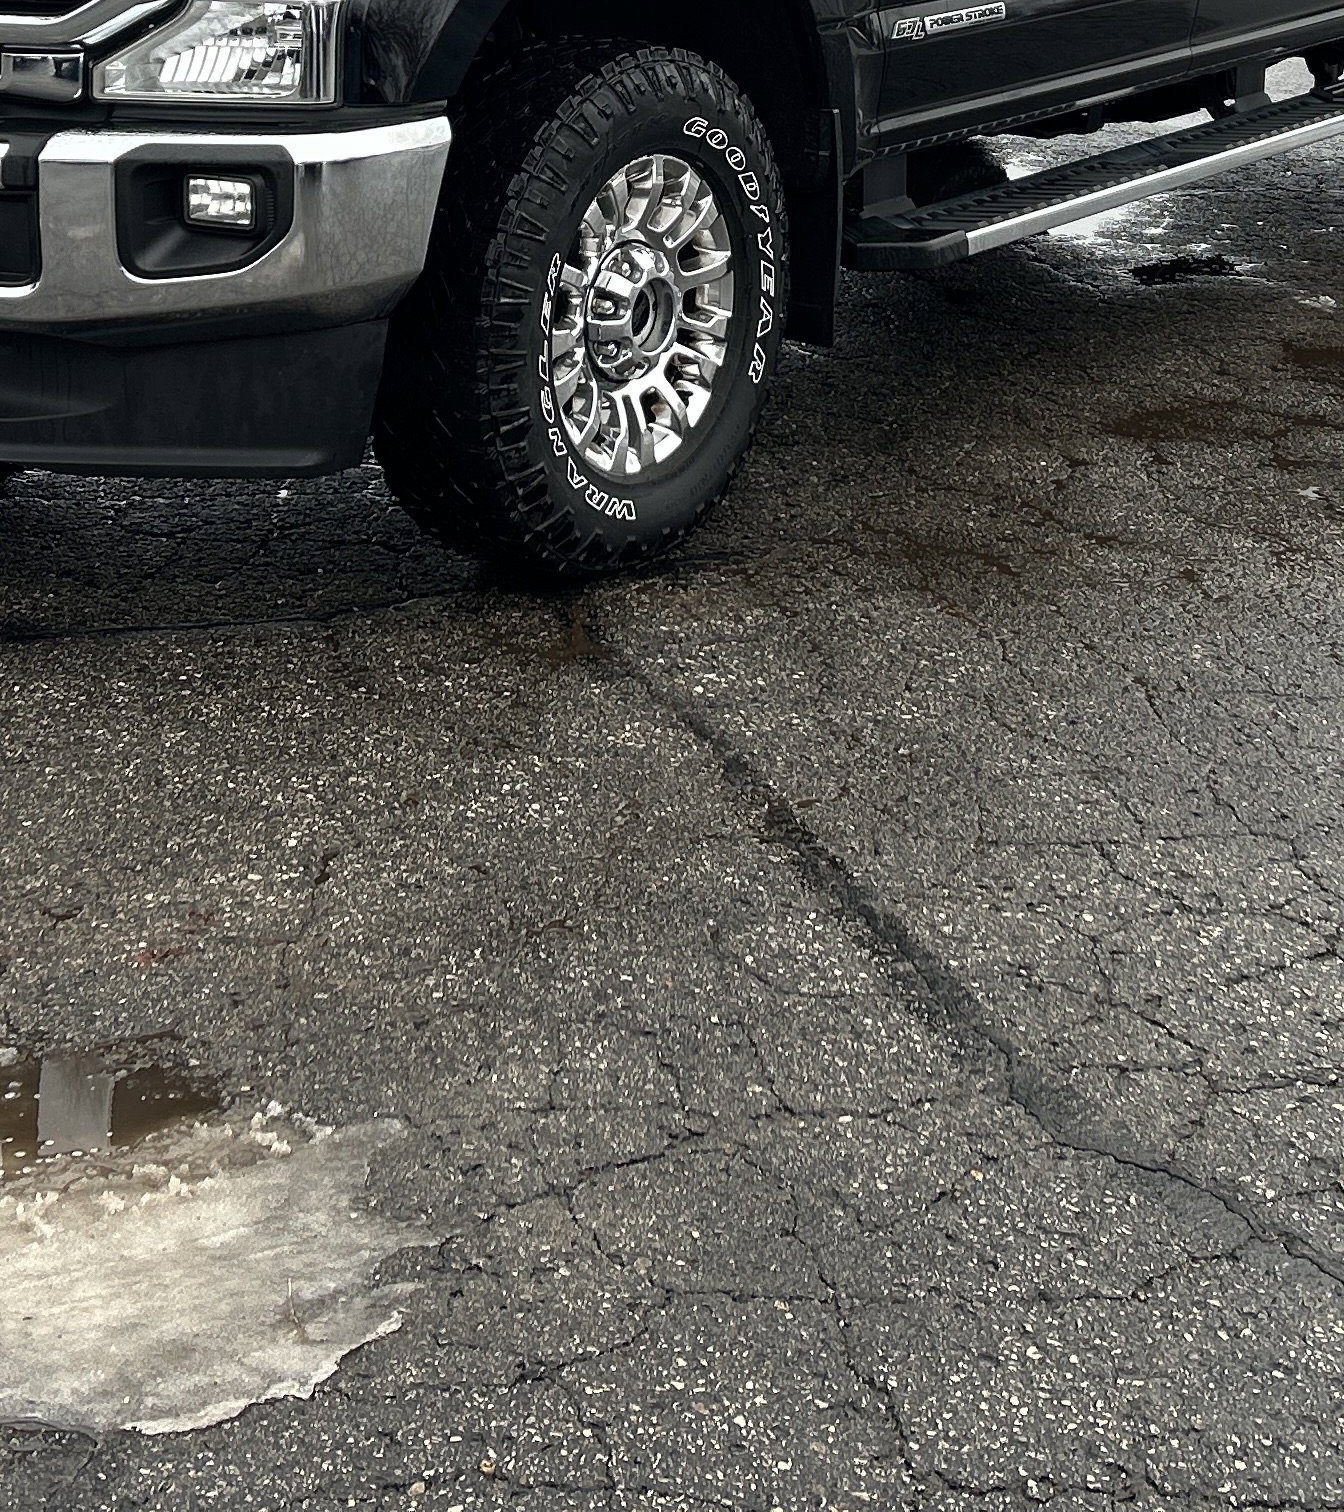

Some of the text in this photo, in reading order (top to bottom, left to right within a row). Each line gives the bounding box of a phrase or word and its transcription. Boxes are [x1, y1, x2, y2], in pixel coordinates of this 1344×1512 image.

[965, 4, 1004, 22] STROKE
[683, 116, 775, 383] GOODYEAR
[538, 252, 637, 521] WRANGLER
